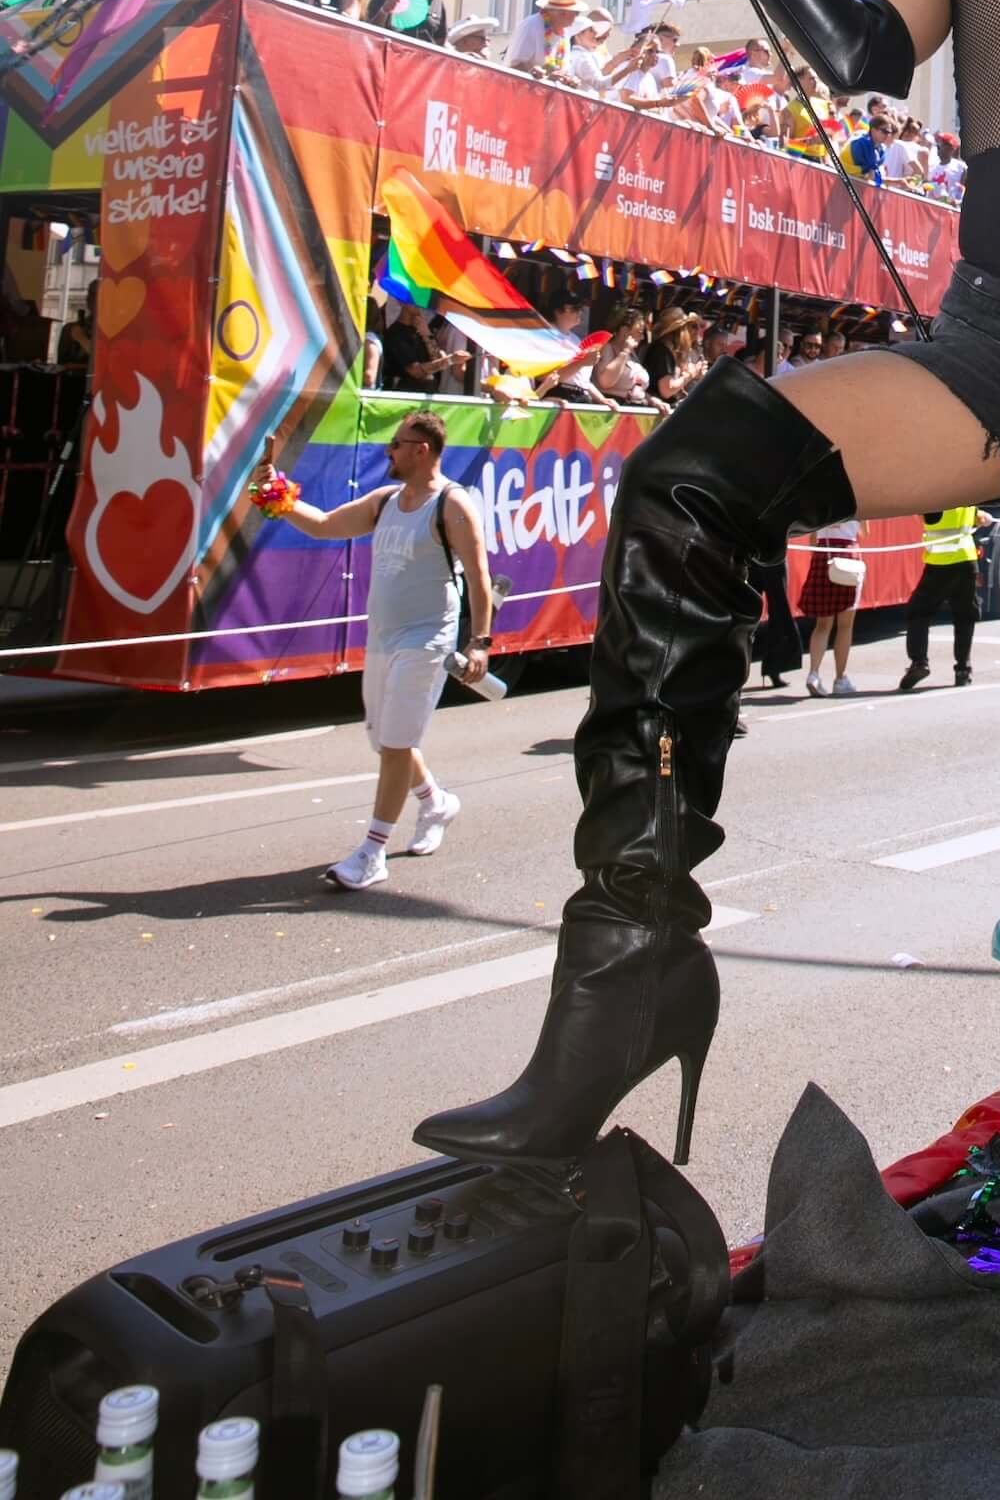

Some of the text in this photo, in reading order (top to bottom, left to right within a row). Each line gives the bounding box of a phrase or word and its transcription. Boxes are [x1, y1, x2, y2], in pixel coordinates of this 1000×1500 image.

[180, 109, 218, 146] ist
[465, 124, 508, 159] Berliner
[113, 151, 206, 181] unsere
[617, 165, 665, 194] Berliner
[107, 180, 209, 224] stärke!
[616, 194, 676, 224] Sparkasse
[748, 203, 846, 250] bsk Immobilien
